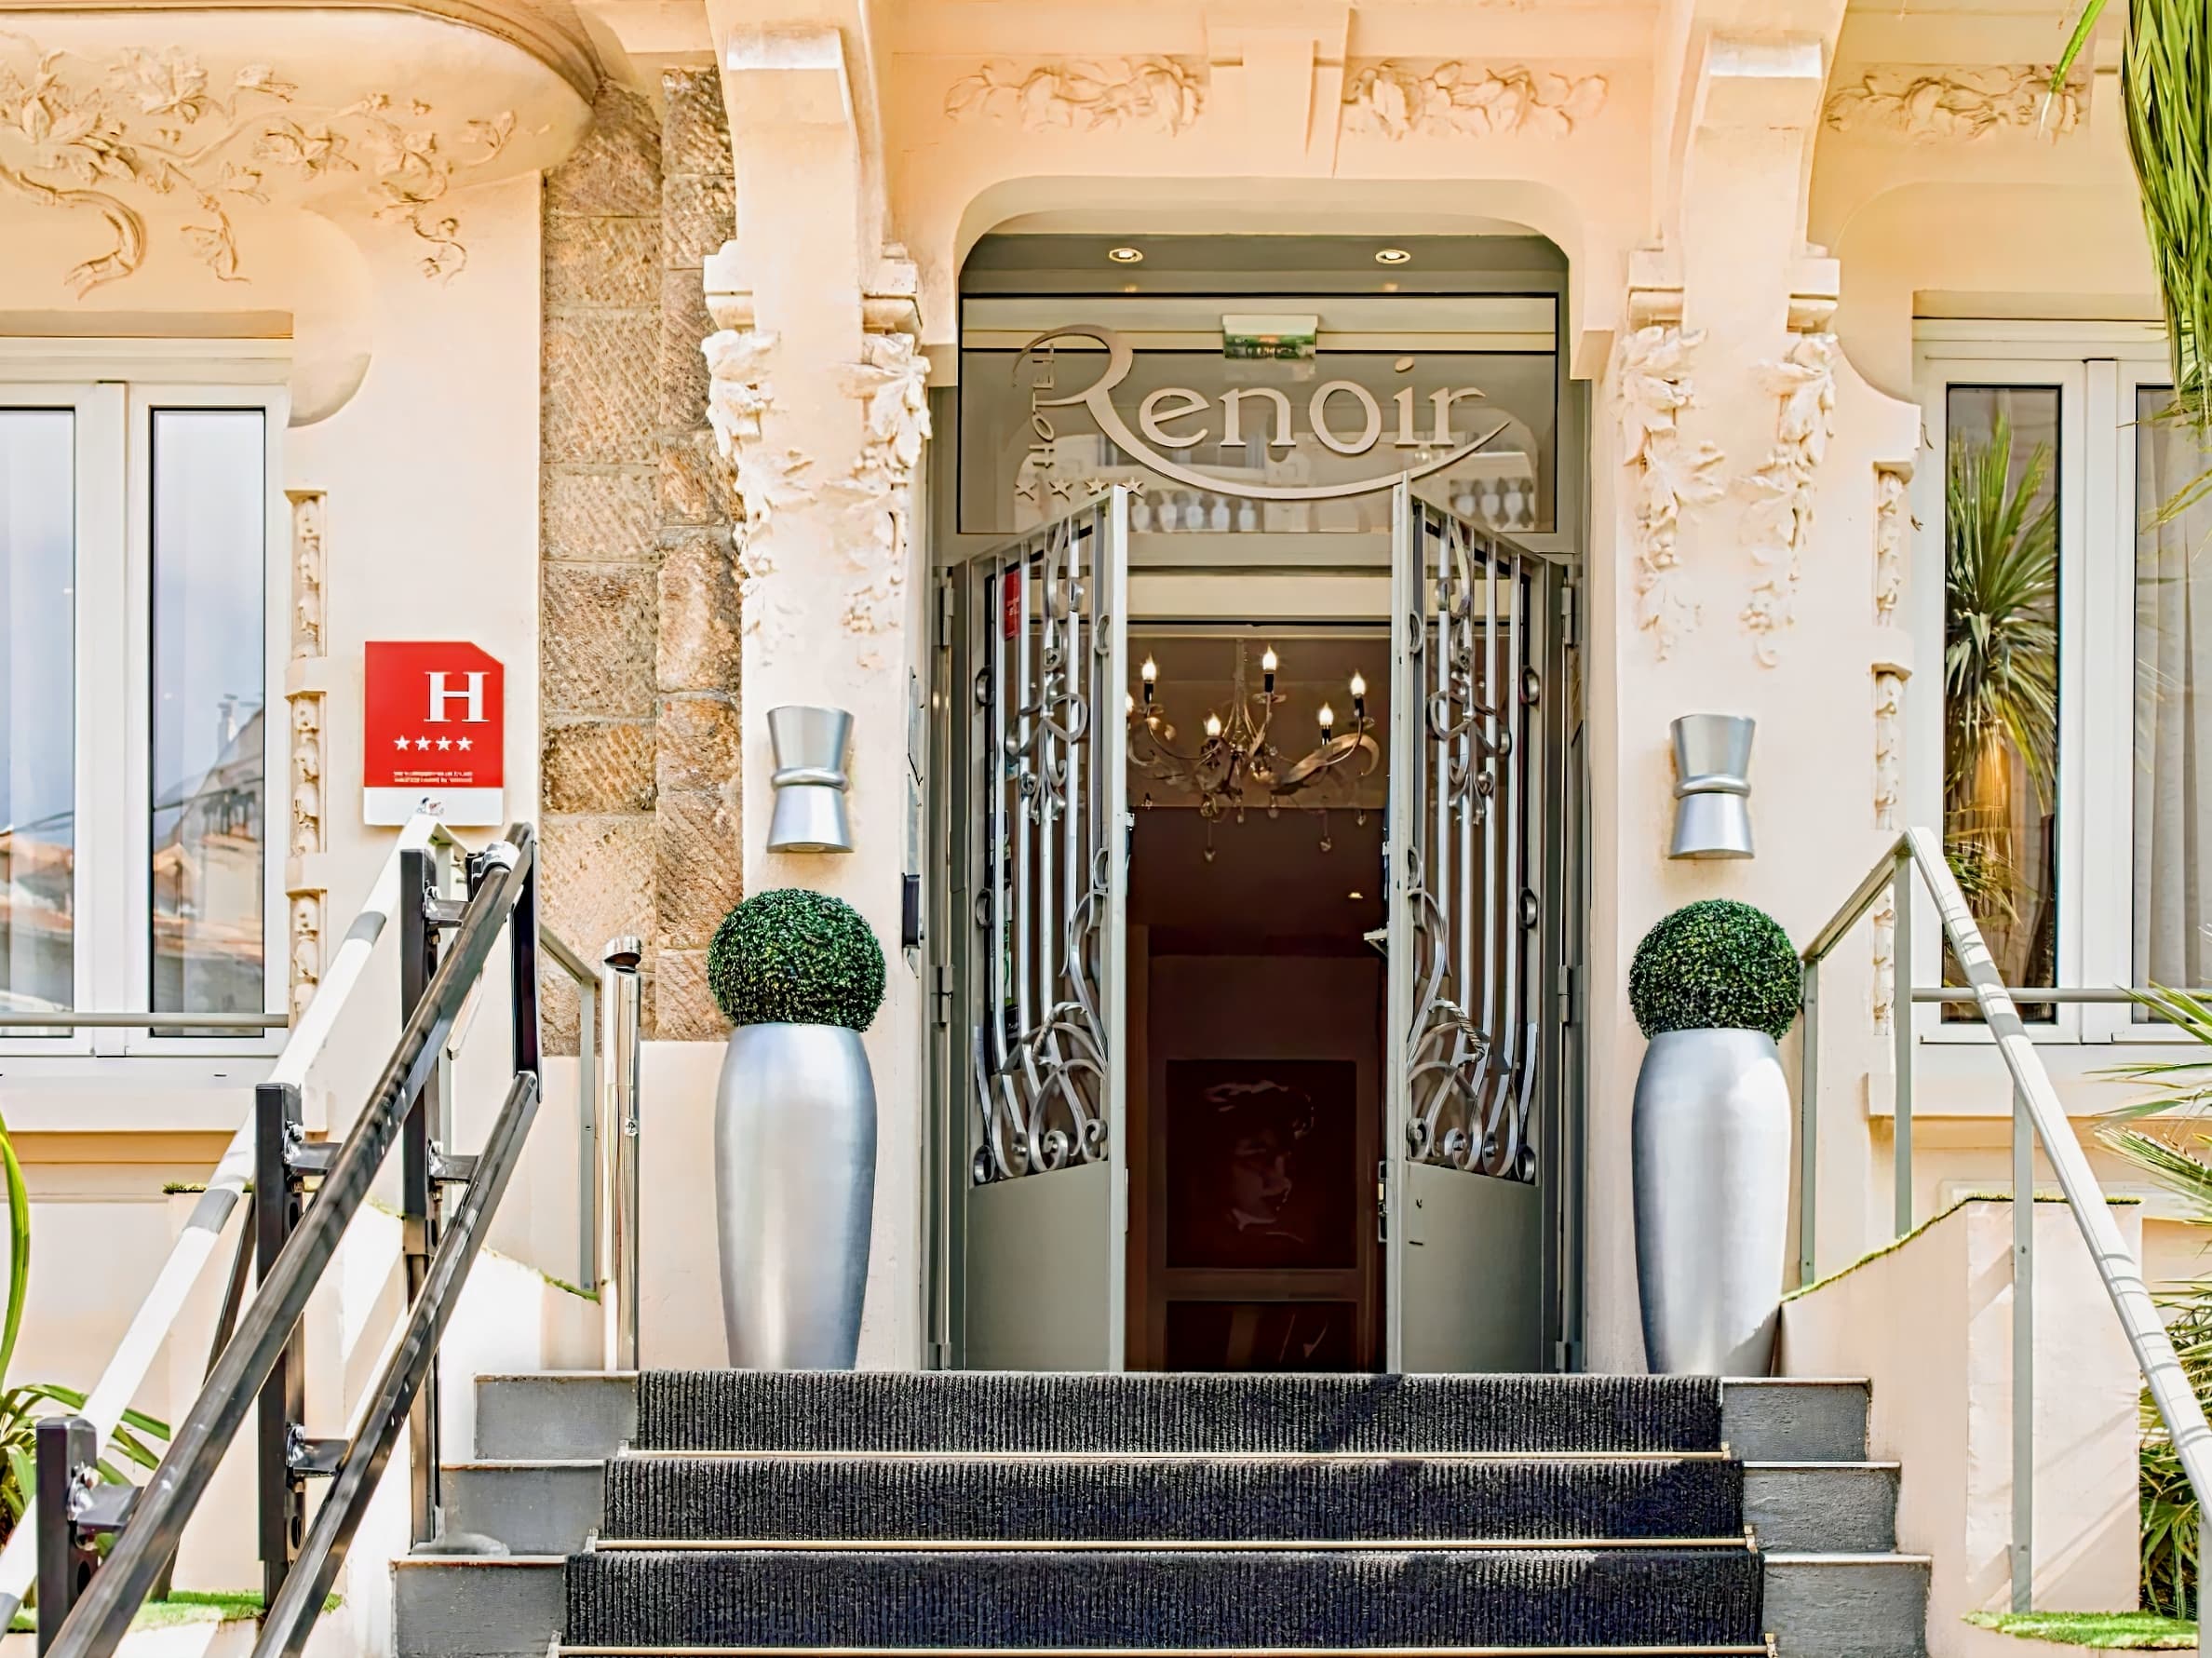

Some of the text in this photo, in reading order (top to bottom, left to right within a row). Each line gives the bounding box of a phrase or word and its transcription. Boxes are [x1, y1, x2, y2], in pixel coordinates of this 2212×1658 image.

[1012, 324, 1511, 500] Renoir
[1028, 343, 1055, 468] HOTEL
[423, 671, 491, 722] H
